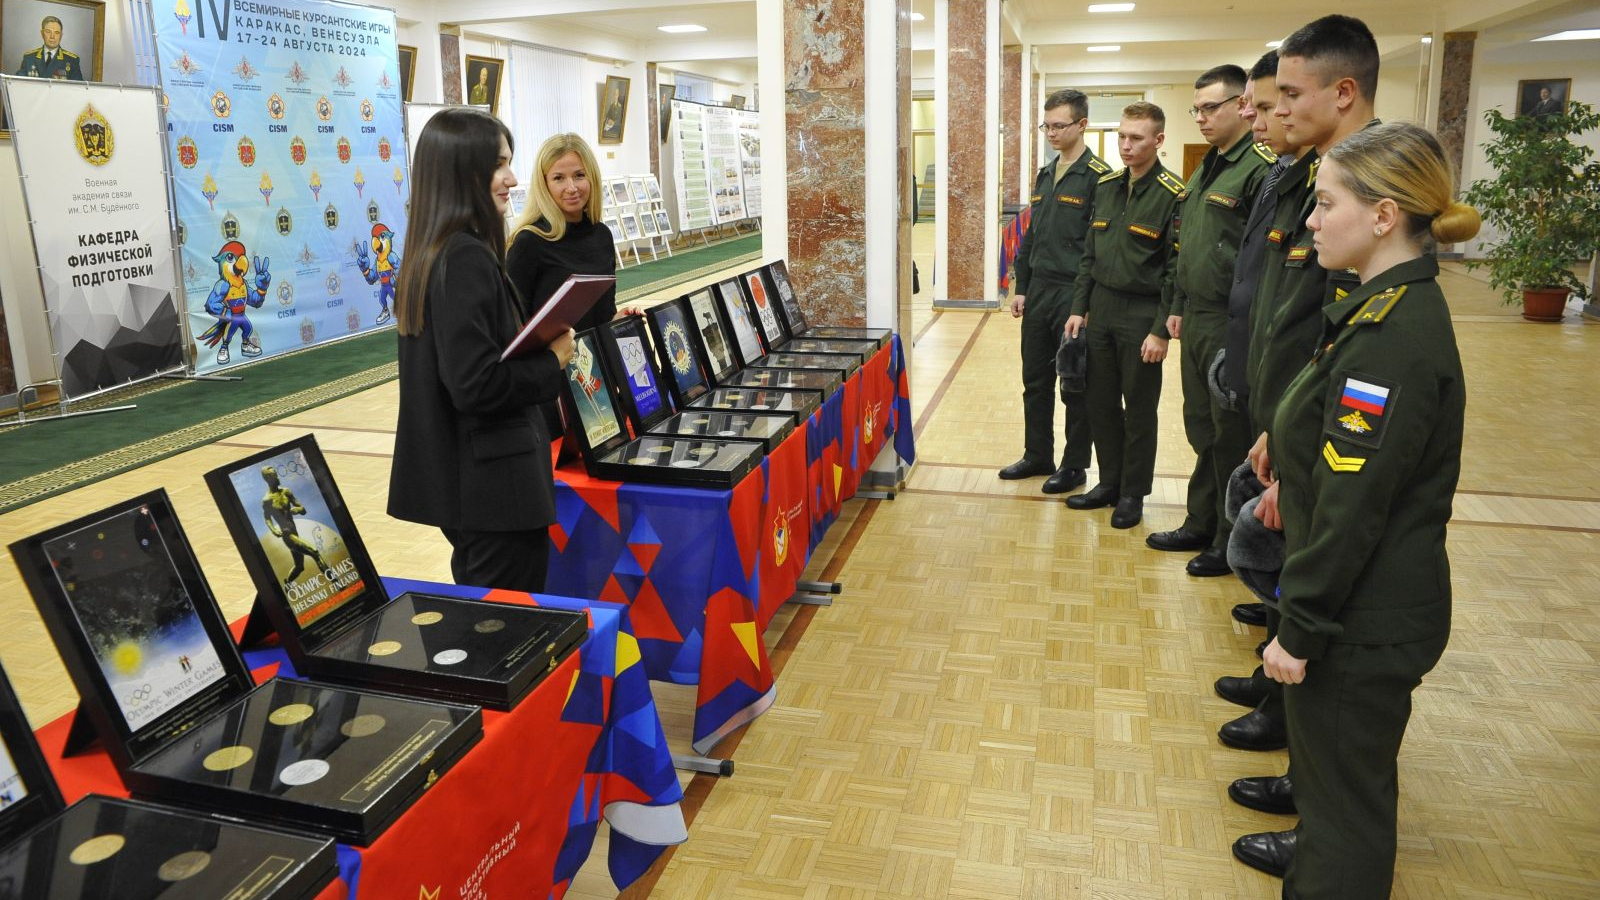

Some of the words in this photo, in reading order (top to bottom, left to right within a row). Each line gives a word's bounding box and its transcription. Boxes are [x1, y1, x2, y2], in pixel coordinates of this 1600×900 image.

[234, 0, 300, 20] ВСЕМИРНЫЕ
[302, 12, 367, 31] КУРСАНТСКИЕ
[369, 23, 391, 34] ИГРЫ
[235, 16, 306, 37] КАРАКАС,
[312, 27, 380, 46] ВЕНЕСУЭЛА
[237, 32, 277, 47] 17-24
[284, 38, 334, 54] АВГУСТА
[339, 46, 366, 57] 2024
[212, 123, 235, 133] CISM
[268, 124, 288, 133] CISM
[317, 125, 335, 133] CISM
[361, 126, 377, 134] CISM
[85, 178, 118, 187] Военная
[72, 192, 110, 201] академия
[111, 191, 133, 199] связи
[78, 229, 140, 247] КАФЕДРА
[67, 243, 153, 268] ФИЗИЧЕСКОЙ
[71, 264, 154, 288] ПОДГОТОВКИ
[277, 308, 296, 319] CISM
[287, 573, 326, 602] OLYMPIC
[324, 557, 354, 582] GAMES
[292, 588, 328, 614] HELSINKI
[329, 571, 359, 594] FINLAND
[460, 821, 520, 896] ЦЕНТРАЛЬНЫЙ
